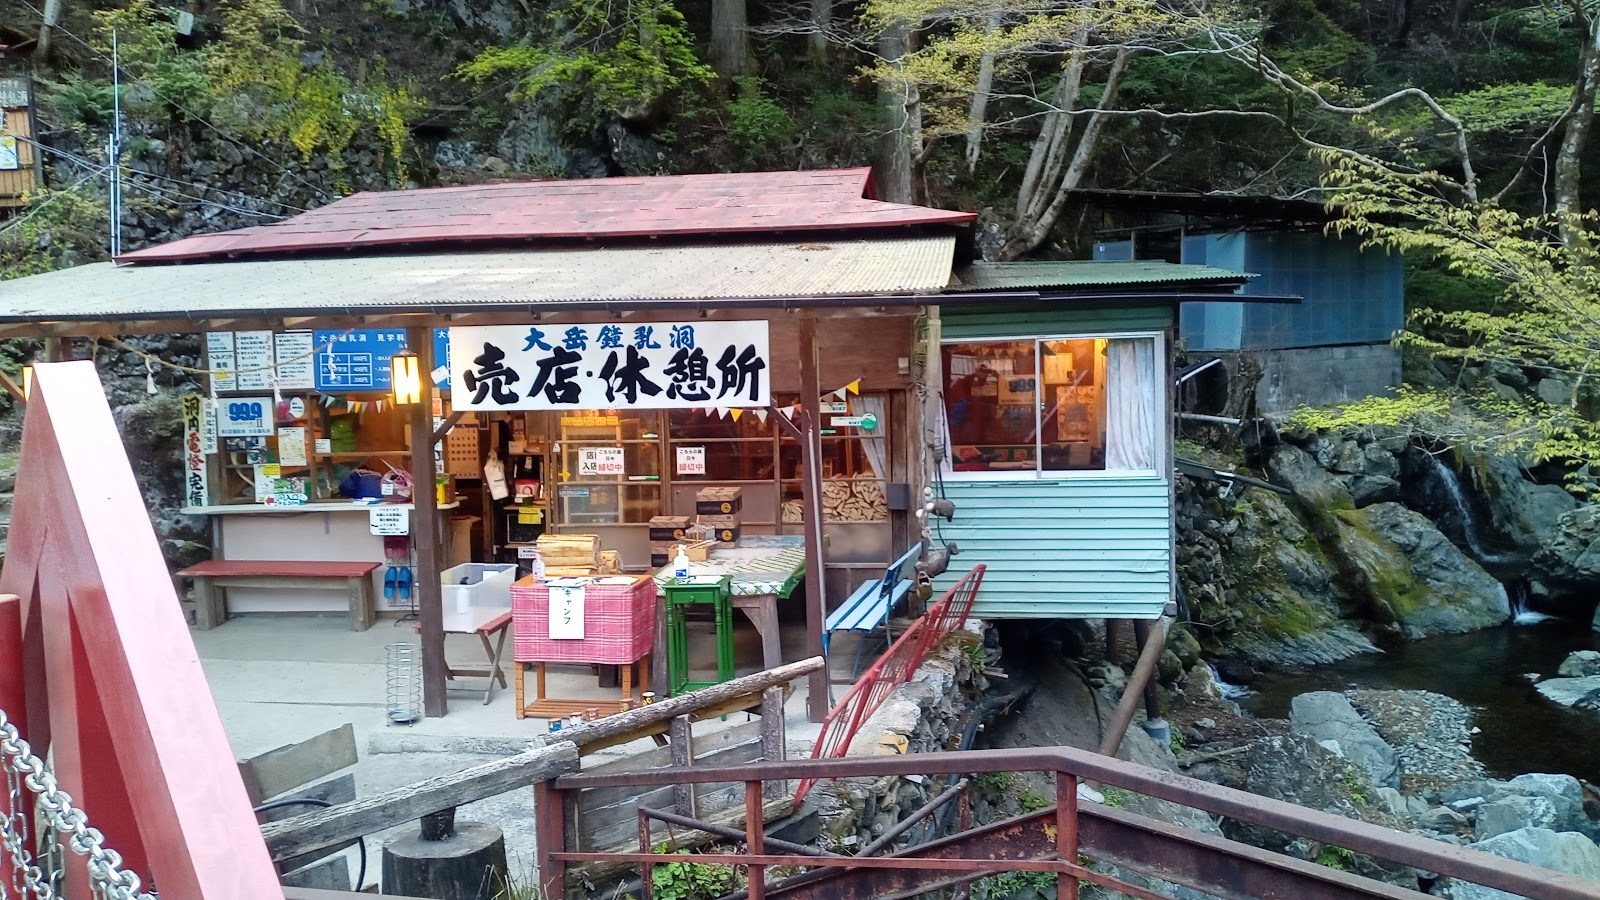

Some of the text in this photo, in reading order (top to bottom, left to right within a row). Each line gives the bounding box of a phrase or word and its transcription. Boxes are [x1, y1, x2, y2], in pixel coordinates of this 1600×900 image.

[522, 324, 695, 352] 大岳鐘乳洞
[462, 341, 767, 405] 売店・休憩所
